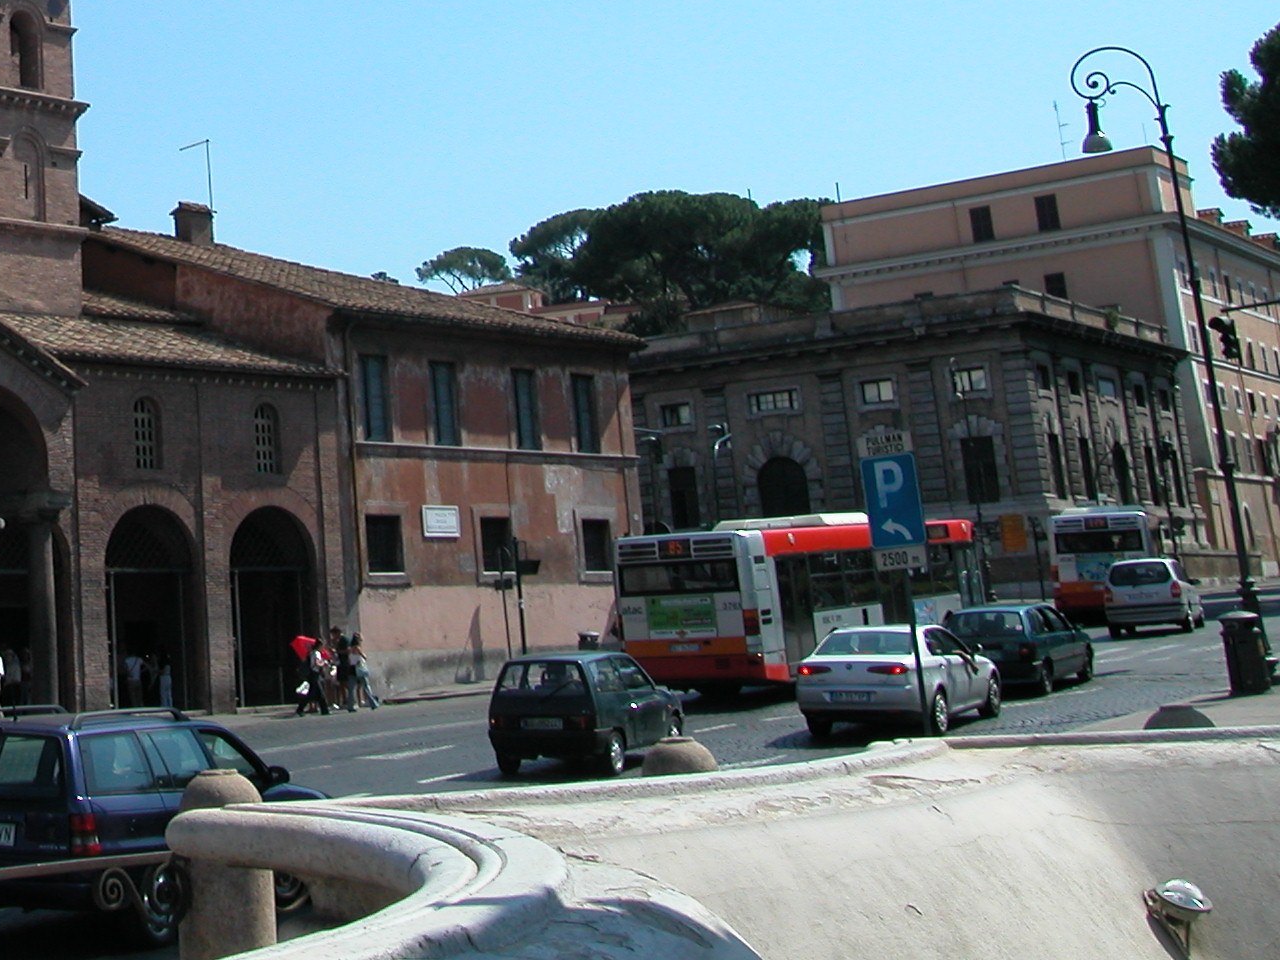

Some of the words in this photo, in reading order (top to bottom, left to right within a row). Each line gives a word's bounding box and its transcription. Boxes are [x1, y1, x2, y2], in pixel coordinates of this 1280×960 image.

[866, 433, 903, 447] PULLMAN
[873, 460, 903, 508] P
[881, 551, 909, 567] 2500
